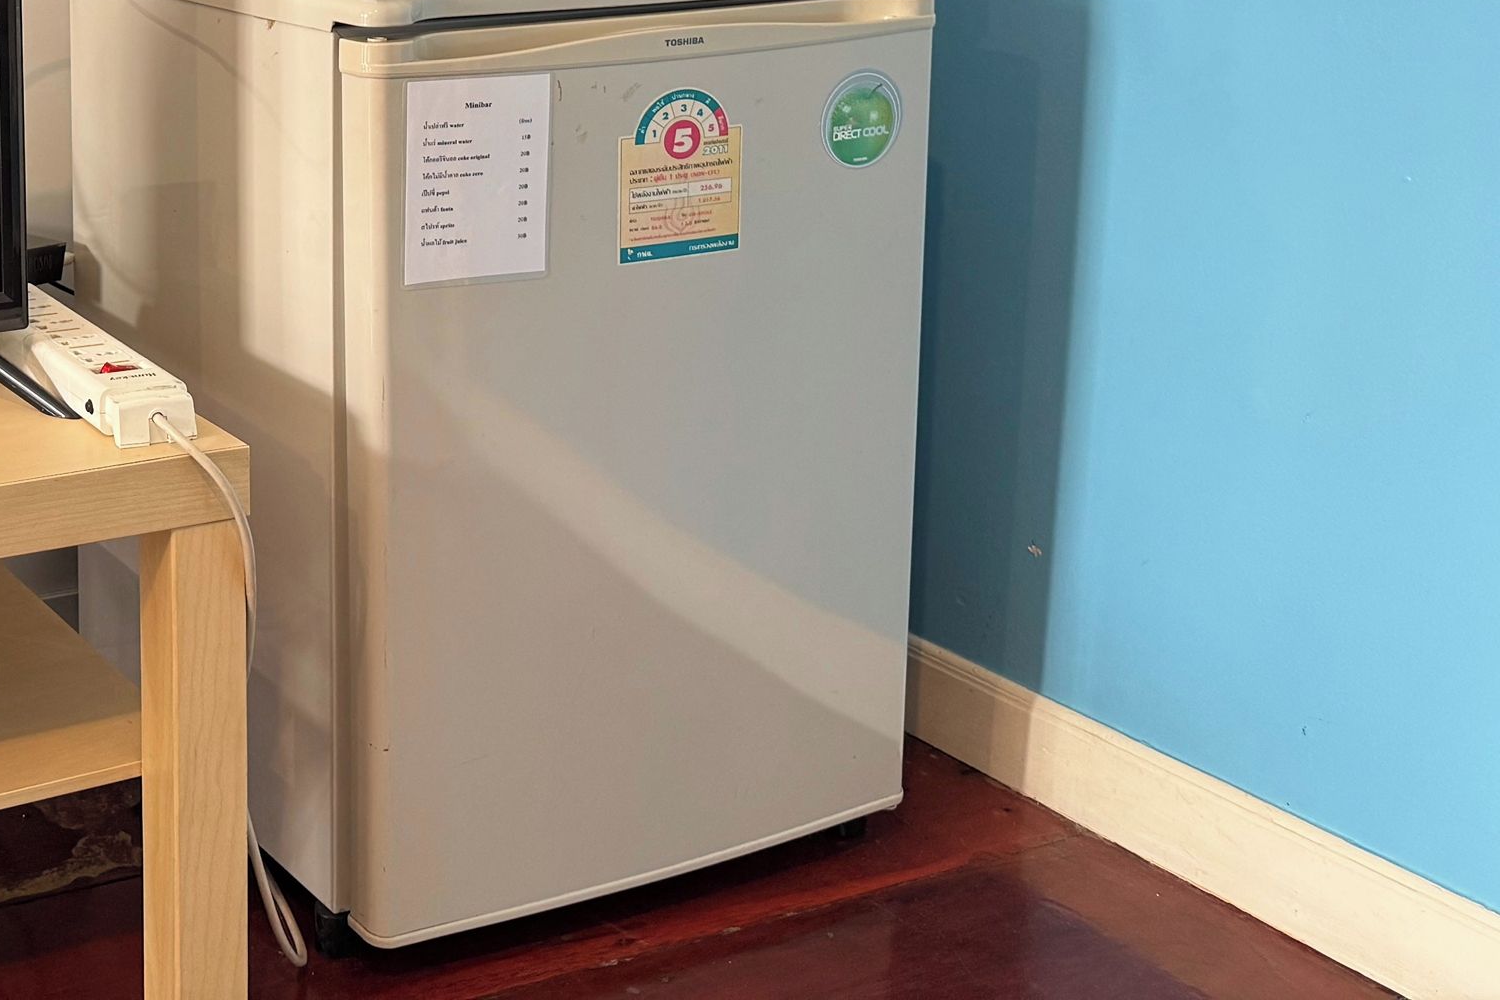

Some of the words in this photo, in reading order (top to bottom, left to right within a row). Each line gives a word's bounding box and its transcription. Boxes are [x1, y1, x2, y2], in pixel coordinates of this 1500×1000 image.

[664, 37, 705, 47] TOSHIBA
[465, 101, 493, 109] Minibar
[652, 130, 657, 138] 1
[662, 112, 669, 120] 2
[680, 104, 687, 112] 3
[708, 124, 714, 132] 5
[833, 128, 862, 141] DIRECT
[862, 124, 890, 137] COOL
[672, 127, 693, 153] 5
[702, 144, 728, 156] 2011
